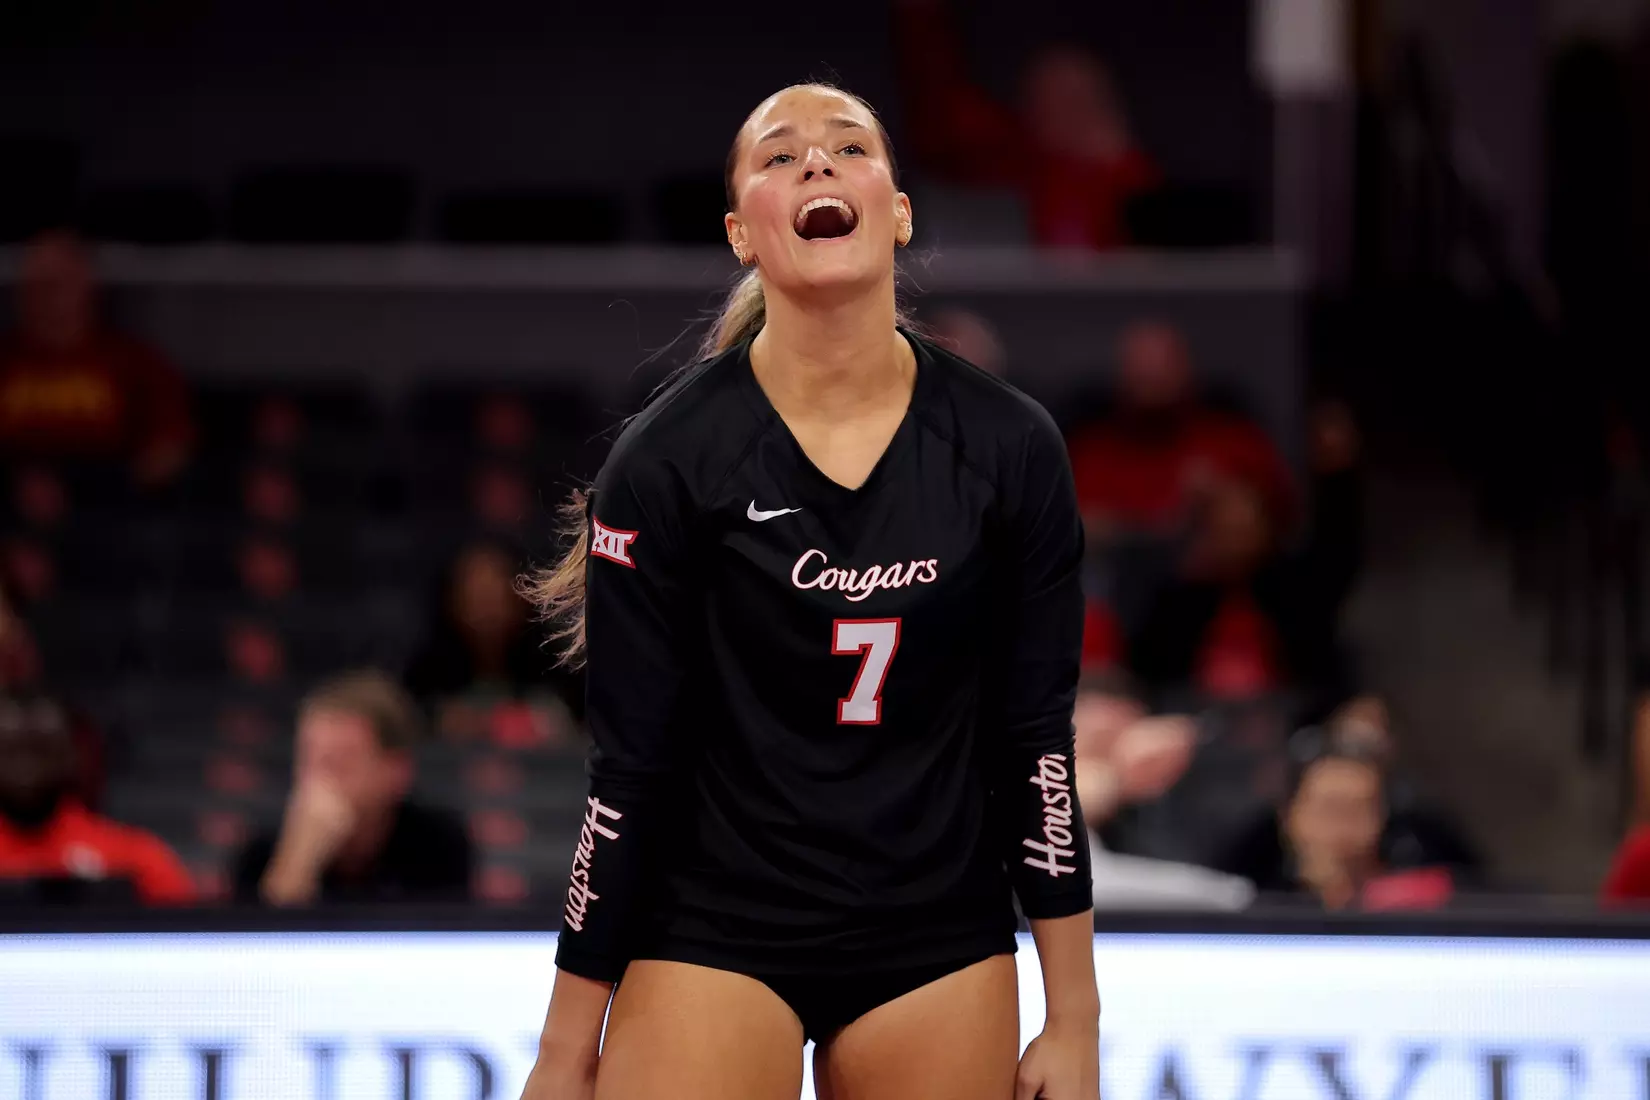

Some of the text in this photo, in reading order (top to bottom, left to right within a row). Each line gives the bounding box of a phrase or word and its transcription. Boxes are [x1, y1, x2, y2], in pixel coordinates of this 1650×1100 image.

[791, 549, 938, 602] Cougars
[831, 617, 902, 725] 7
[564, 795, 623, 932] Houston
